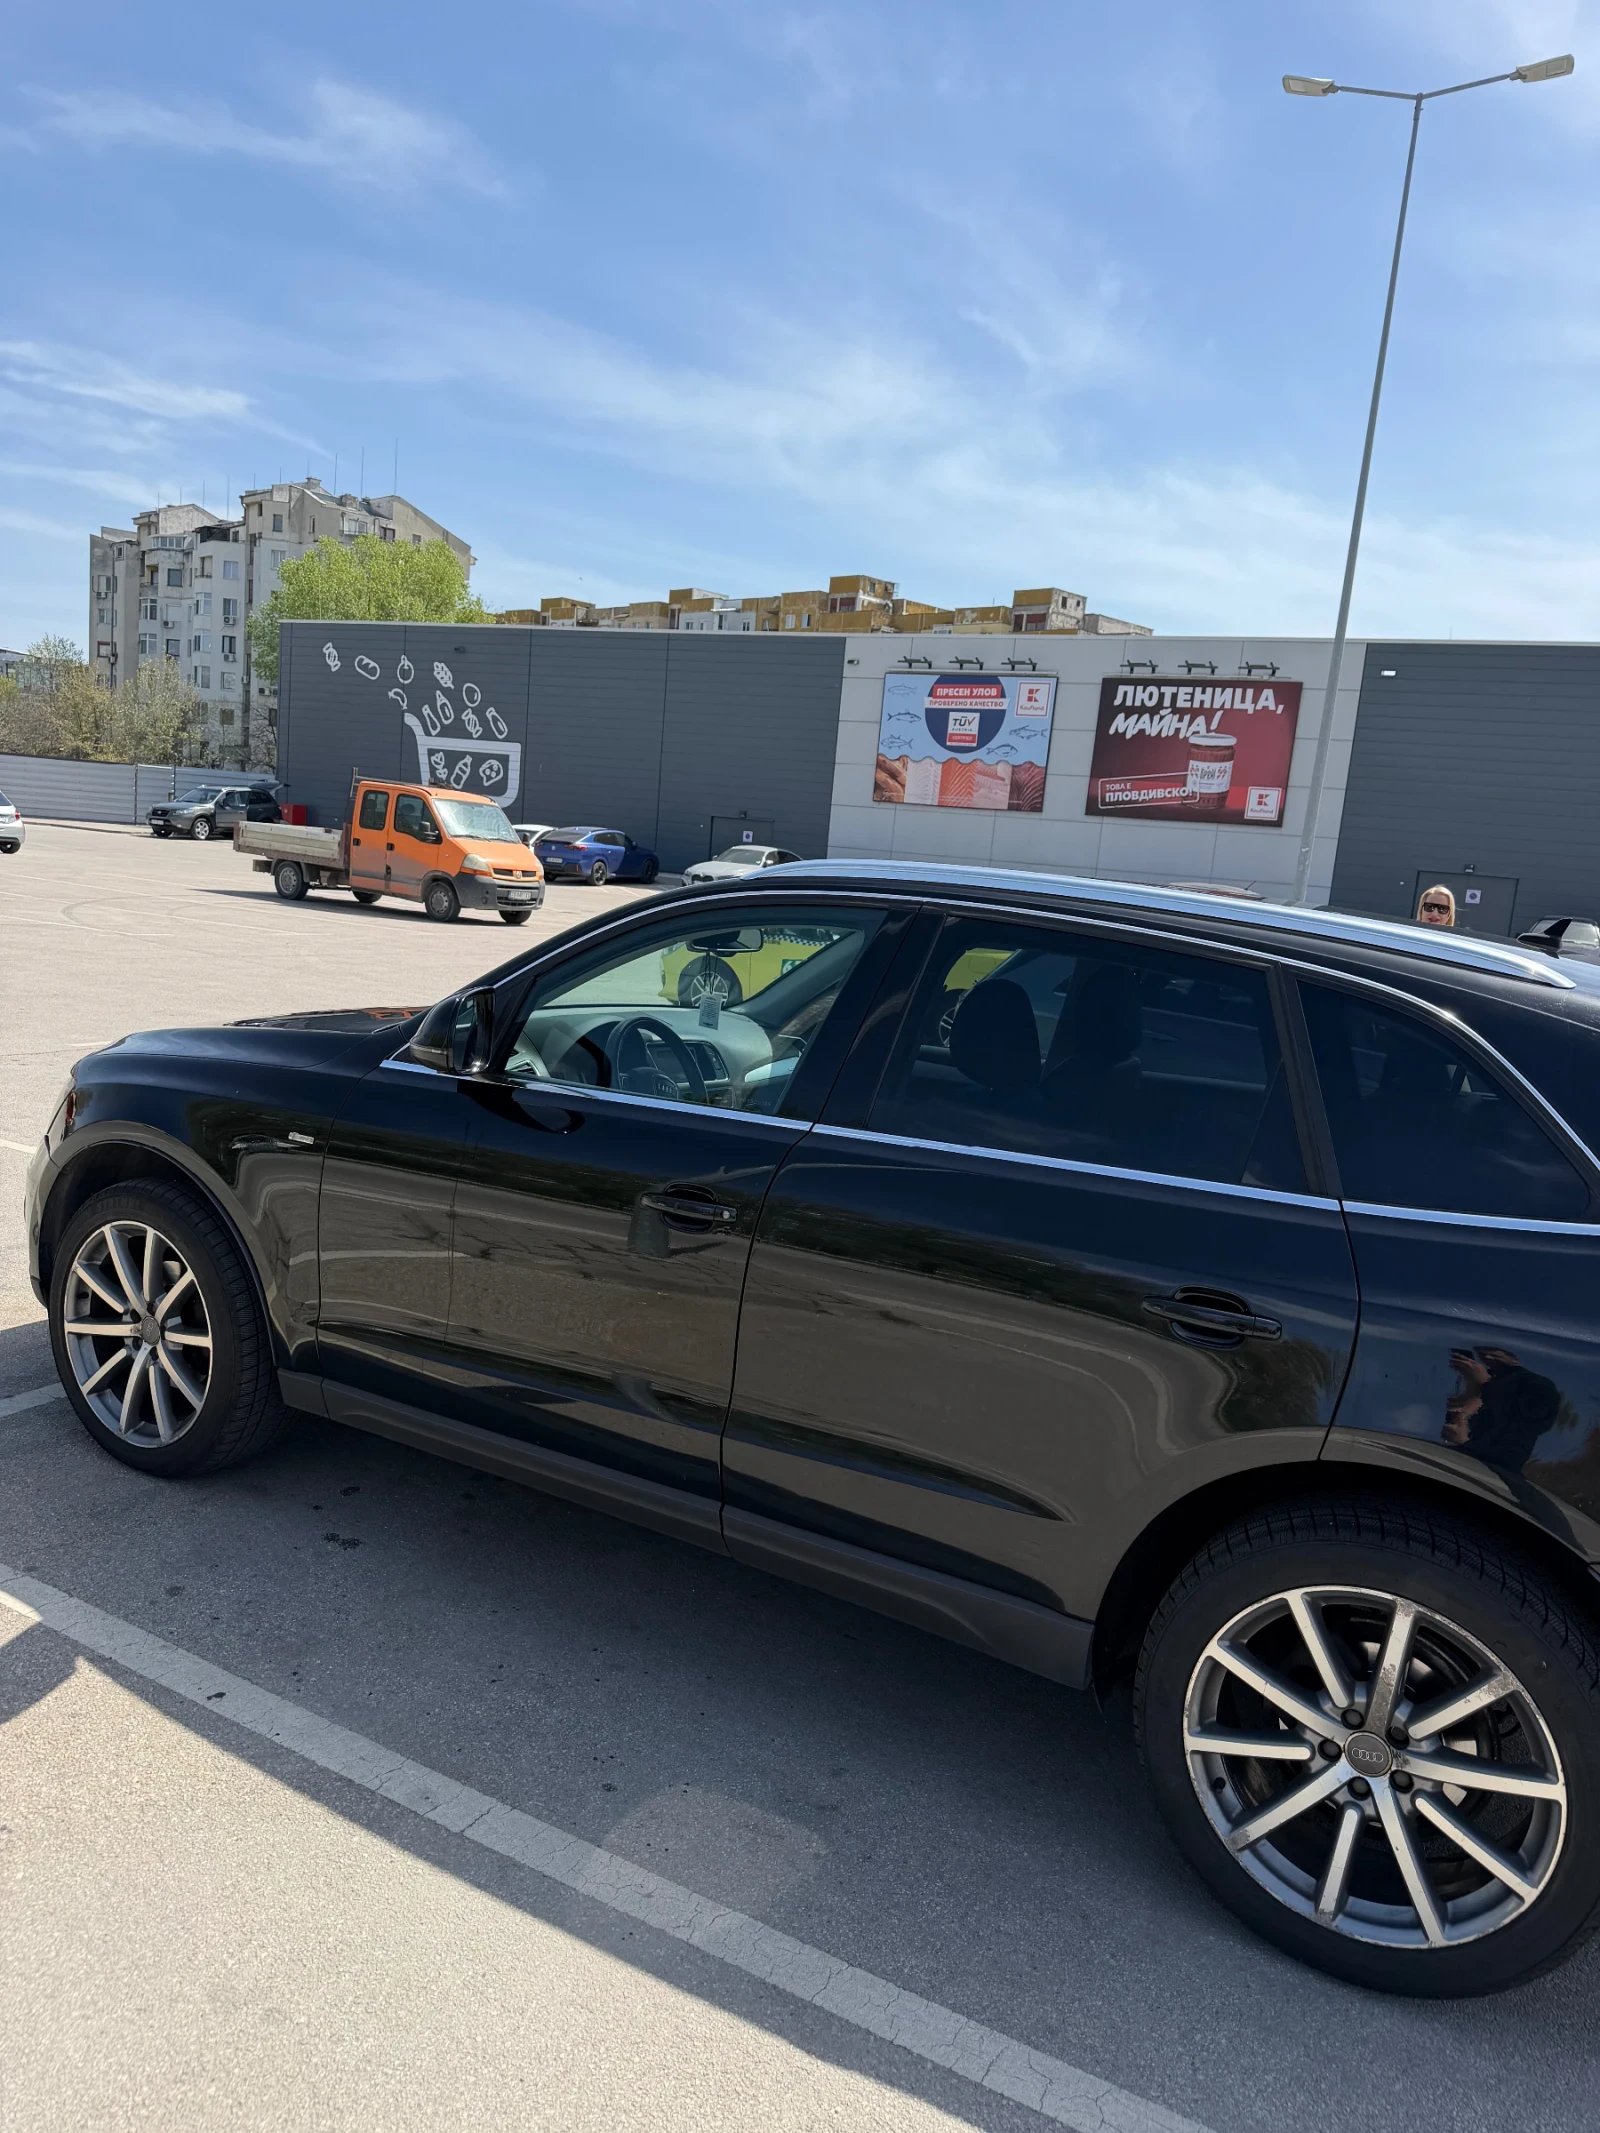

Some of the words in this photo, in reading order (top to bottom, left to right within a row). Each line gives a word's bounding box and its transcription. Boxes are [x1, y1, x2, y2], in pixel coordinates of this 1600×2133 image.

[936, 687, 970, 697] ПРЕСЕН
[972, 687, 998, 697] УЛОВ
[969, 700, 1004, 708] КАЧЕСТВО
[1113, 684, 1285, 715] ЛЮТЕНИЦА,
[1109, 708, 1224, 739] МАЙНА!
[1105, 783, 1125, 792] ТОВА
[1126, 782, 1132, 790] Е
[1105, 786, 1193, 804] ПЛОВДИВСКО!
